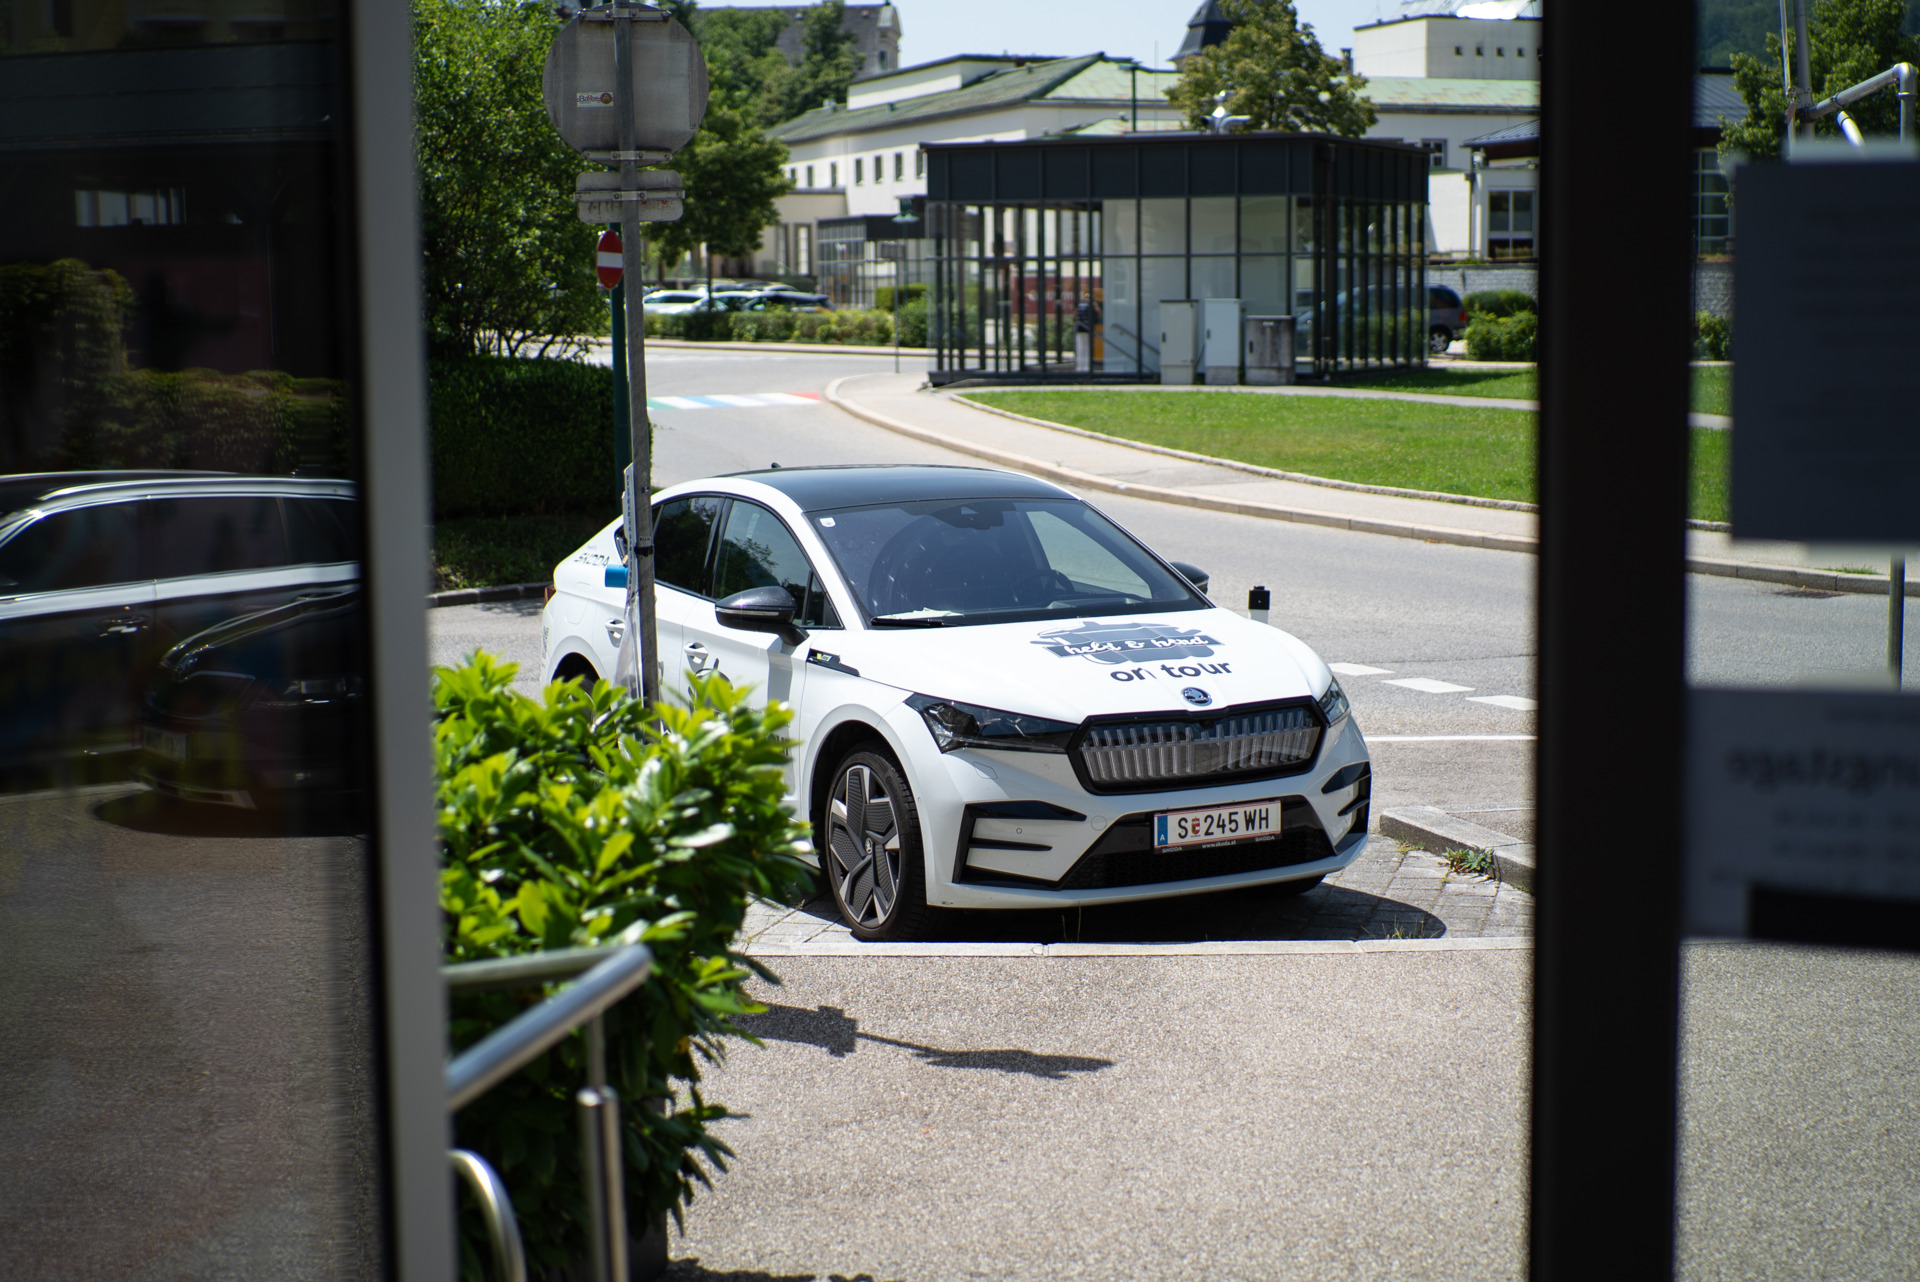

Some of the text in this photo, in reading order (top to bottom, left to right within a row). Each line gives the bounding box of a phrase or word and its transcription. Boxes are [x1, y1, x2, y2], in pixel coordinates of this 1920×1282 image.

[1124, 639, 1145, 649] &
[1110, 662, 1232, 682] on tour
[1177, 807, 1269, 839] S 245 WH
[1160, 833, 1166, 841] A
[1201, 840, 1237, 849] www.skoda.at
